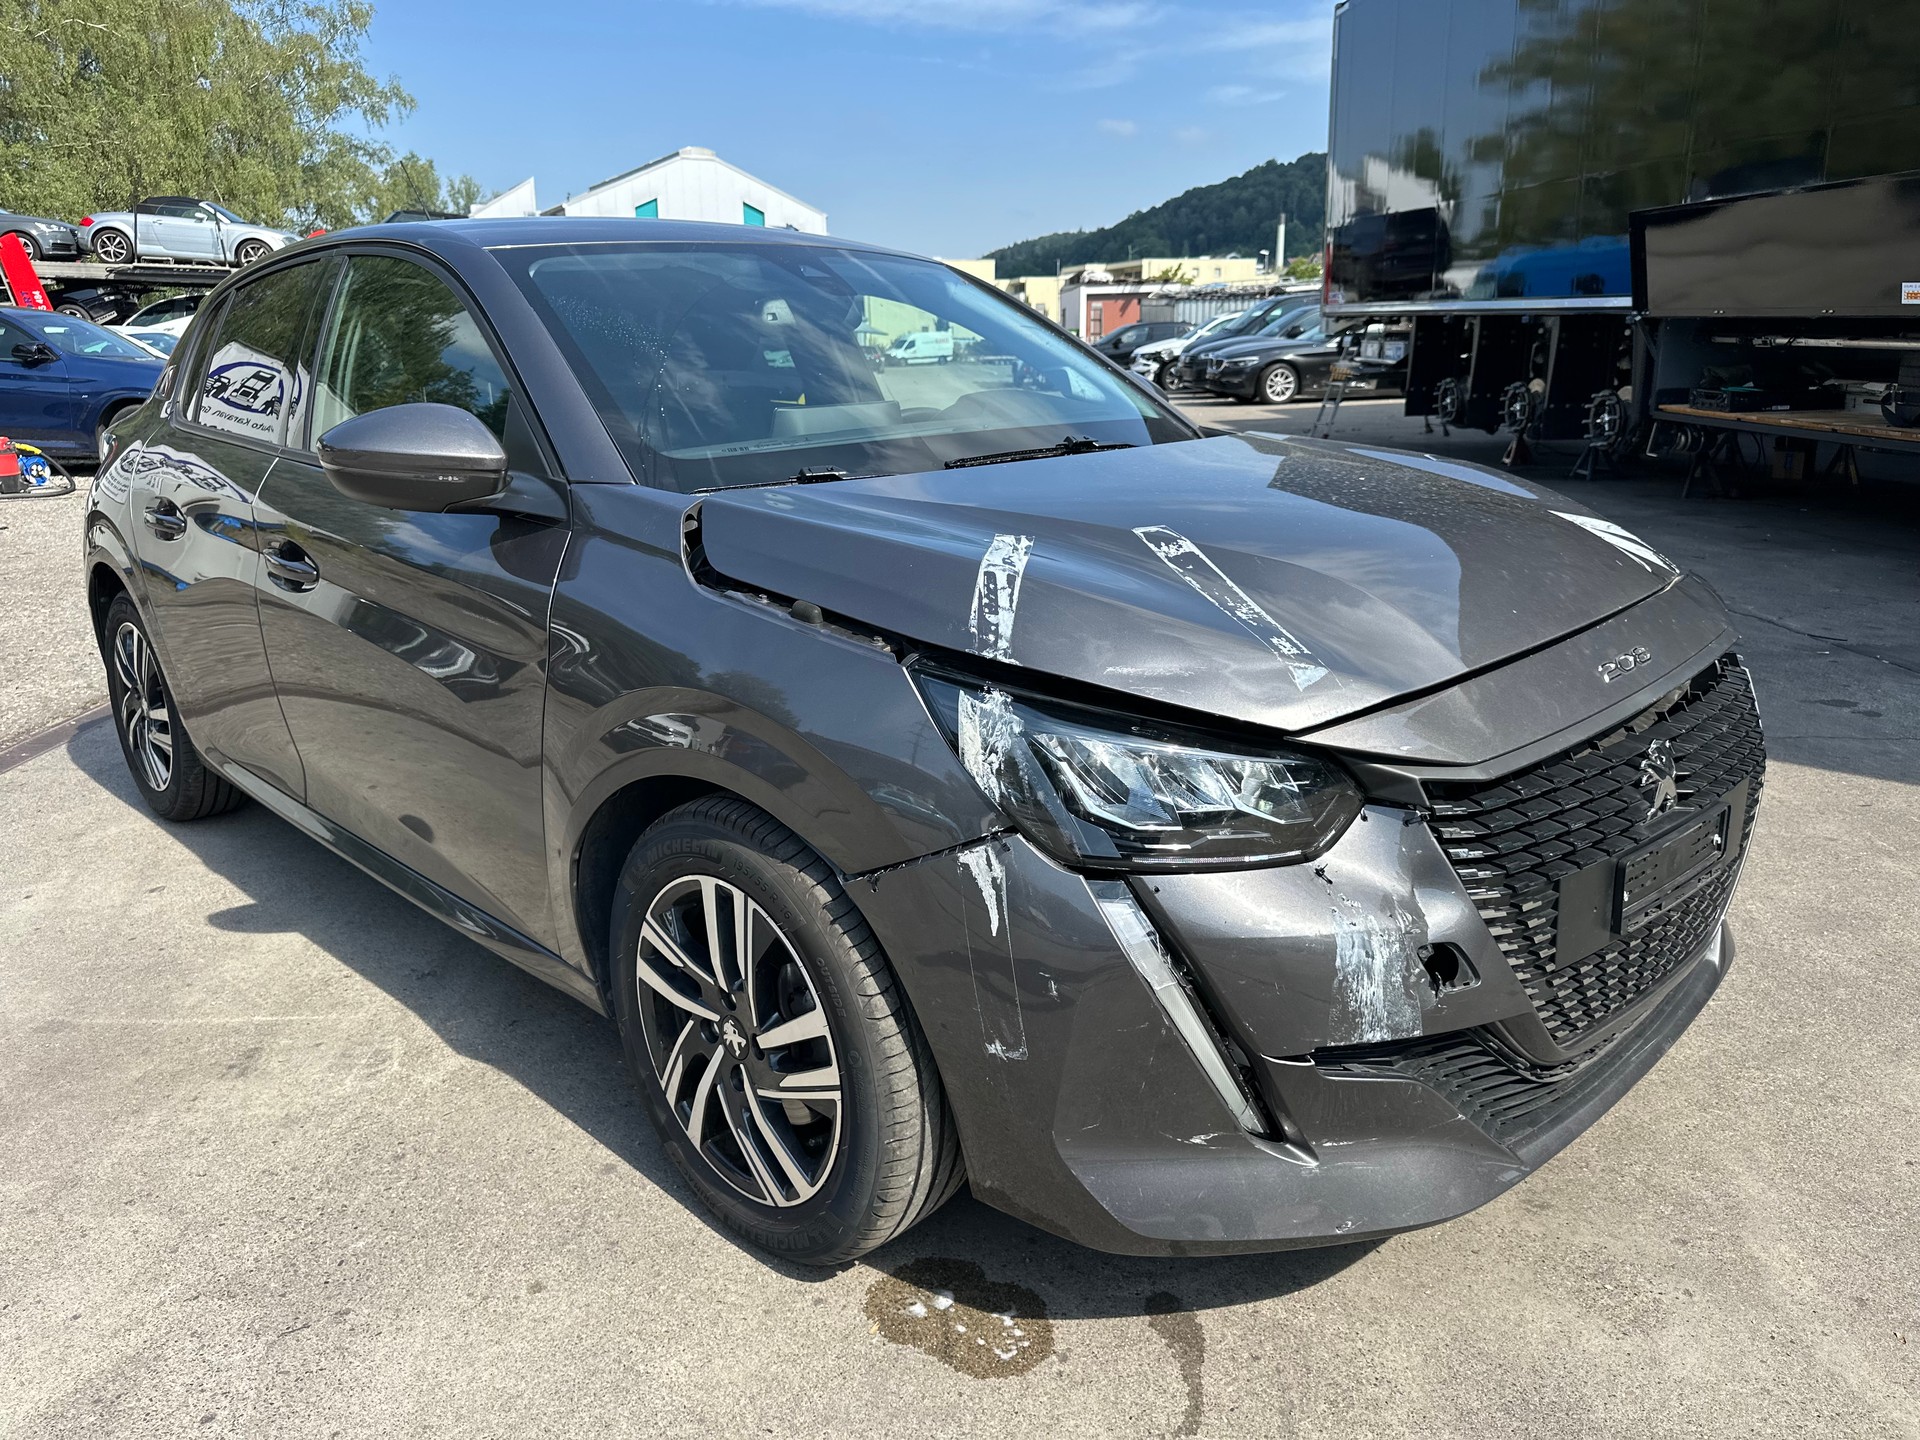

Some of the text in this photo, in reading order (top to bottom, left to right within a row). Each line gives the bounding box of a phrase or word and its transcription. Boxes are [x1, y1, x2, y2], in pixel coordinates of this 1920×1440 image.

[1597, 647, 1652, 683] 208
[647, 838, 722, 864] MICHELIN
[733, 858, 793, 921] 195/55 R 16
[816, 956, 847, 1018] OUTSIDE
